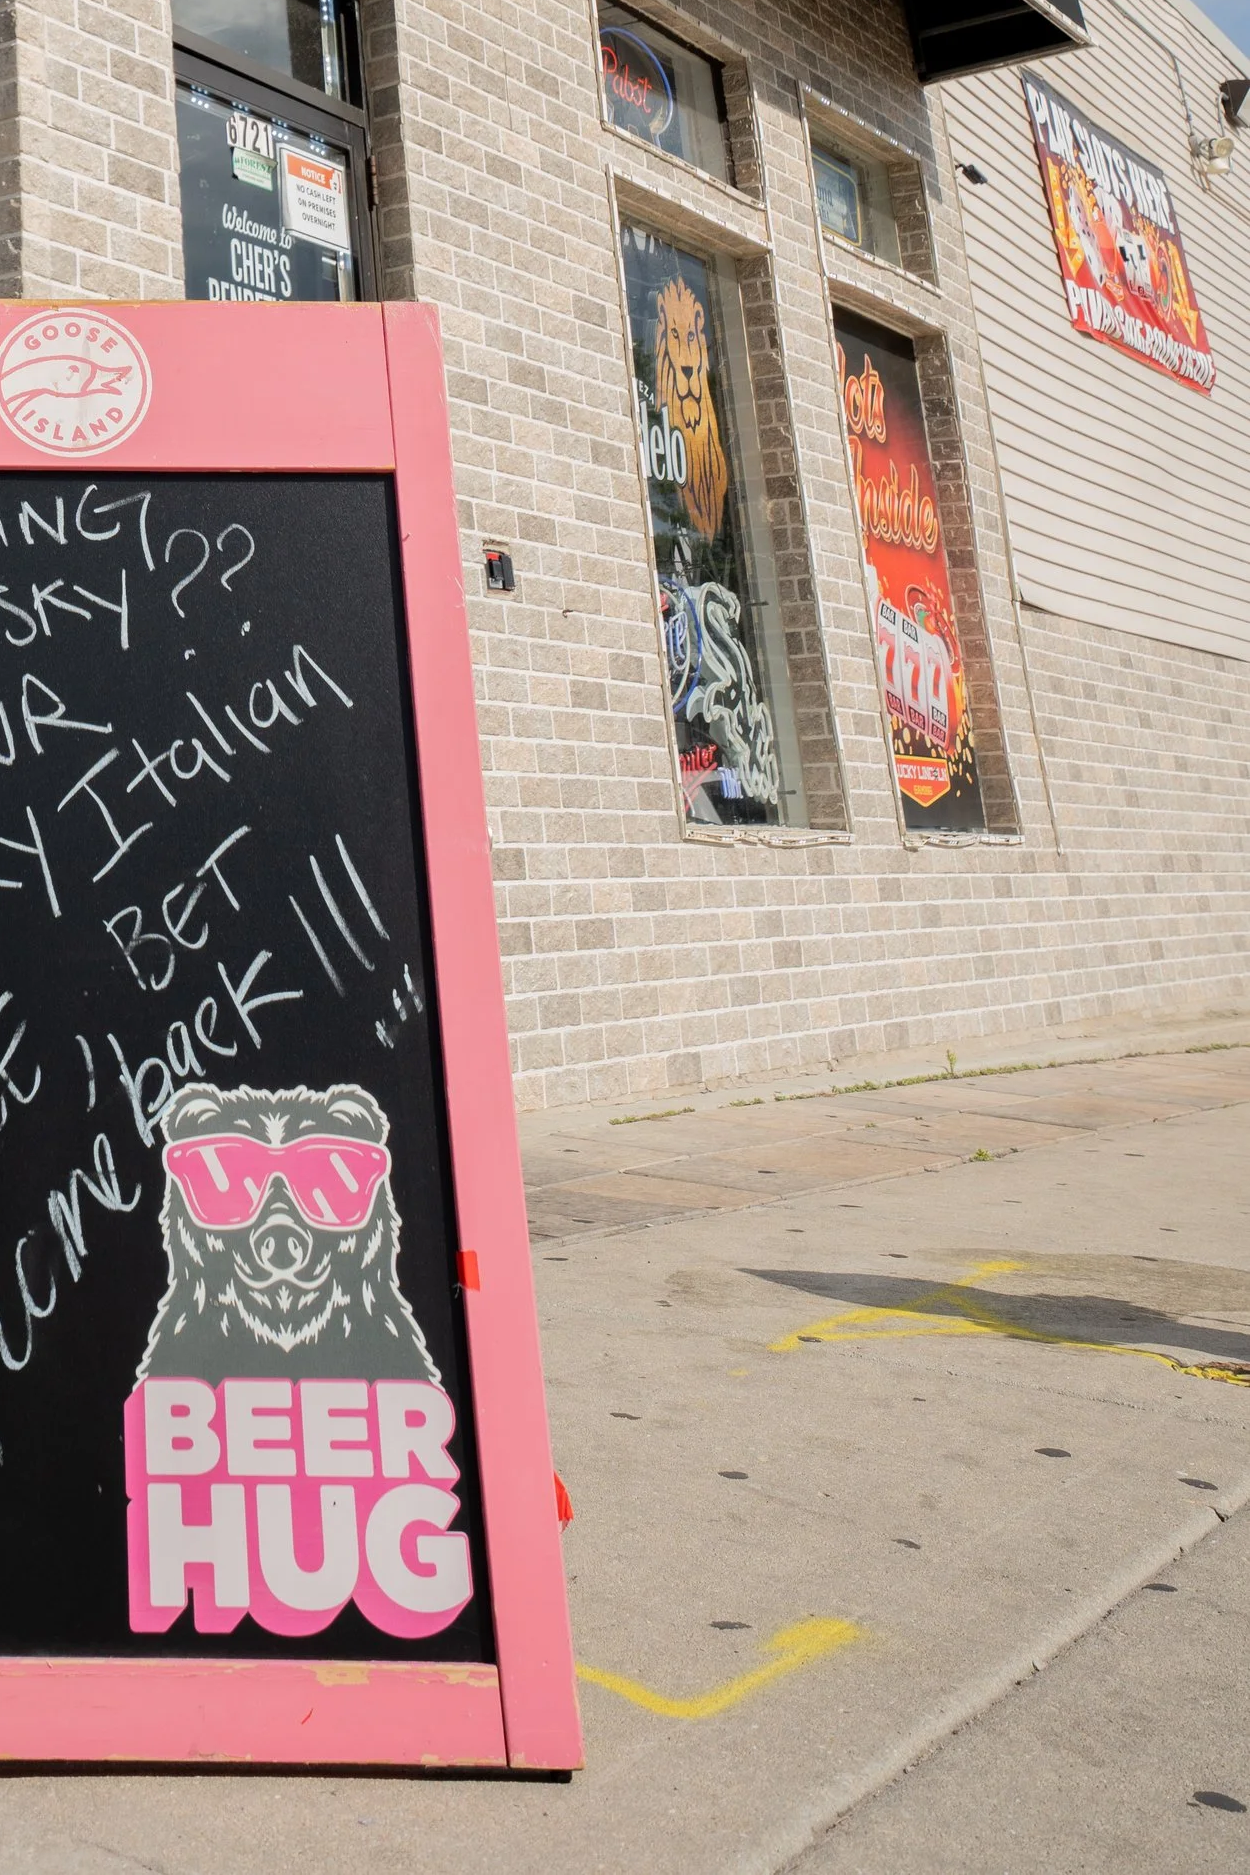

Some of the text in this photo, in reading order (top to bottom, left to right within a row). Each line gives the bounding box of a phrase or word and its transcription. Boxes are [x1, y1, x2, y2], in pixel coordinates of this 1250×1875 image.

[600, 46, 653, 114] Pabst
[228, 115, 271, 159] 6721
[1026, 83, 1176, 235] PLAY SLOTS HERE
[296, 183, 336, 205] NO CASH LEFT
[301, 166, 326, 184] NOTICE
[222, 203, 292, 250] Welcome to
[298, 197, 337, 218] ON PREMISES
[302, 212, 336, 230] OVERNIGHT
[230, 238, 292, 298] CHER'S
[24, 322, 118, 353] GOOSE
[22, 407, 123, 442] ISLAND
[57, 644, 354, 883] Italian
[103, 825, 251, 990] BET
[144, 1379, 461, 1480] BEER
[146, 1482, 473, 1617] HUG
